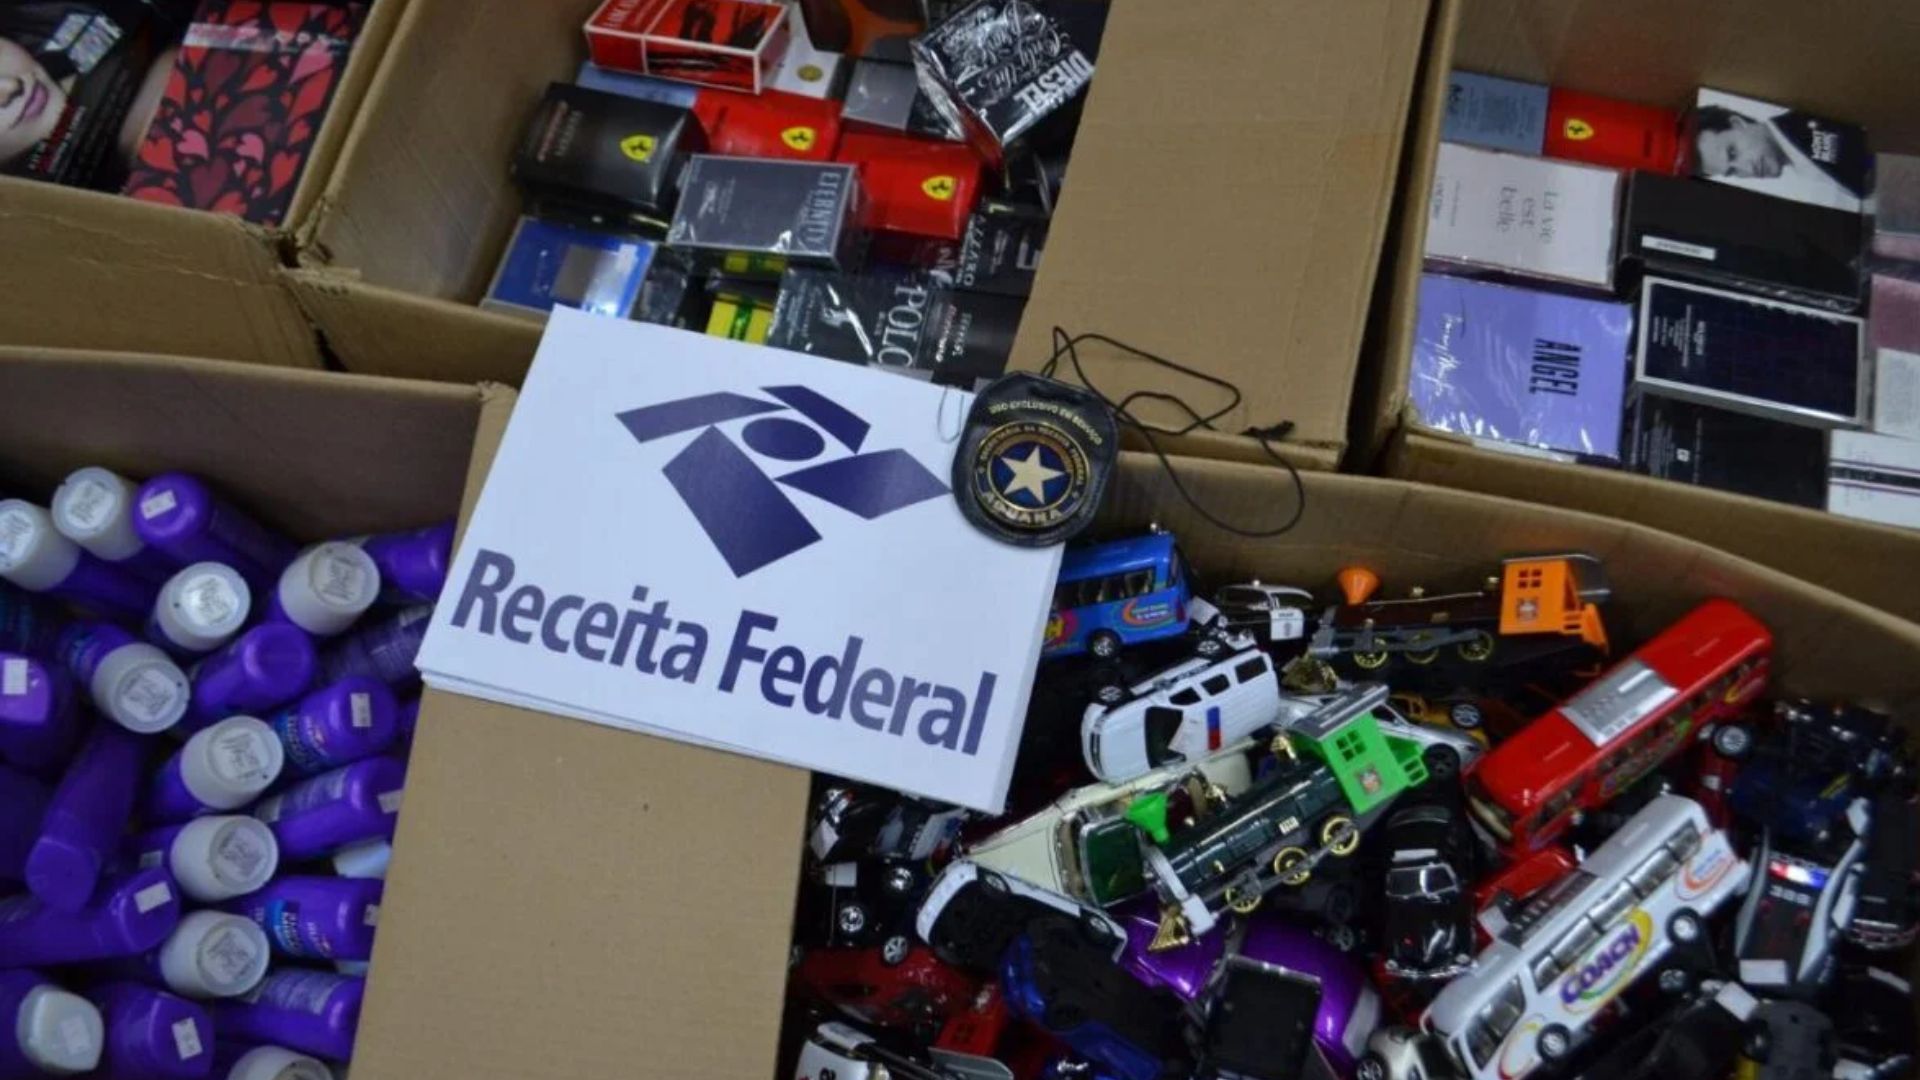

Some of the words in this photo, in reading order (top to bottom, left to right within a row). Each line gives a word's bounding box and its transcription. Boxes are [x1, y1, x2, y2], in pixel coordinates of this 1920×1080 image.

[1013, 50, 1095, 116] DIESEL
[806, 172, 842, 244] ETERNITY
[1529, 338, 1582, 396] ANGEL
[450, 548, 709, 684] Receita
[717, 608, 998, 756] Federal
[1562, 924, 1640, 1004] COACH
